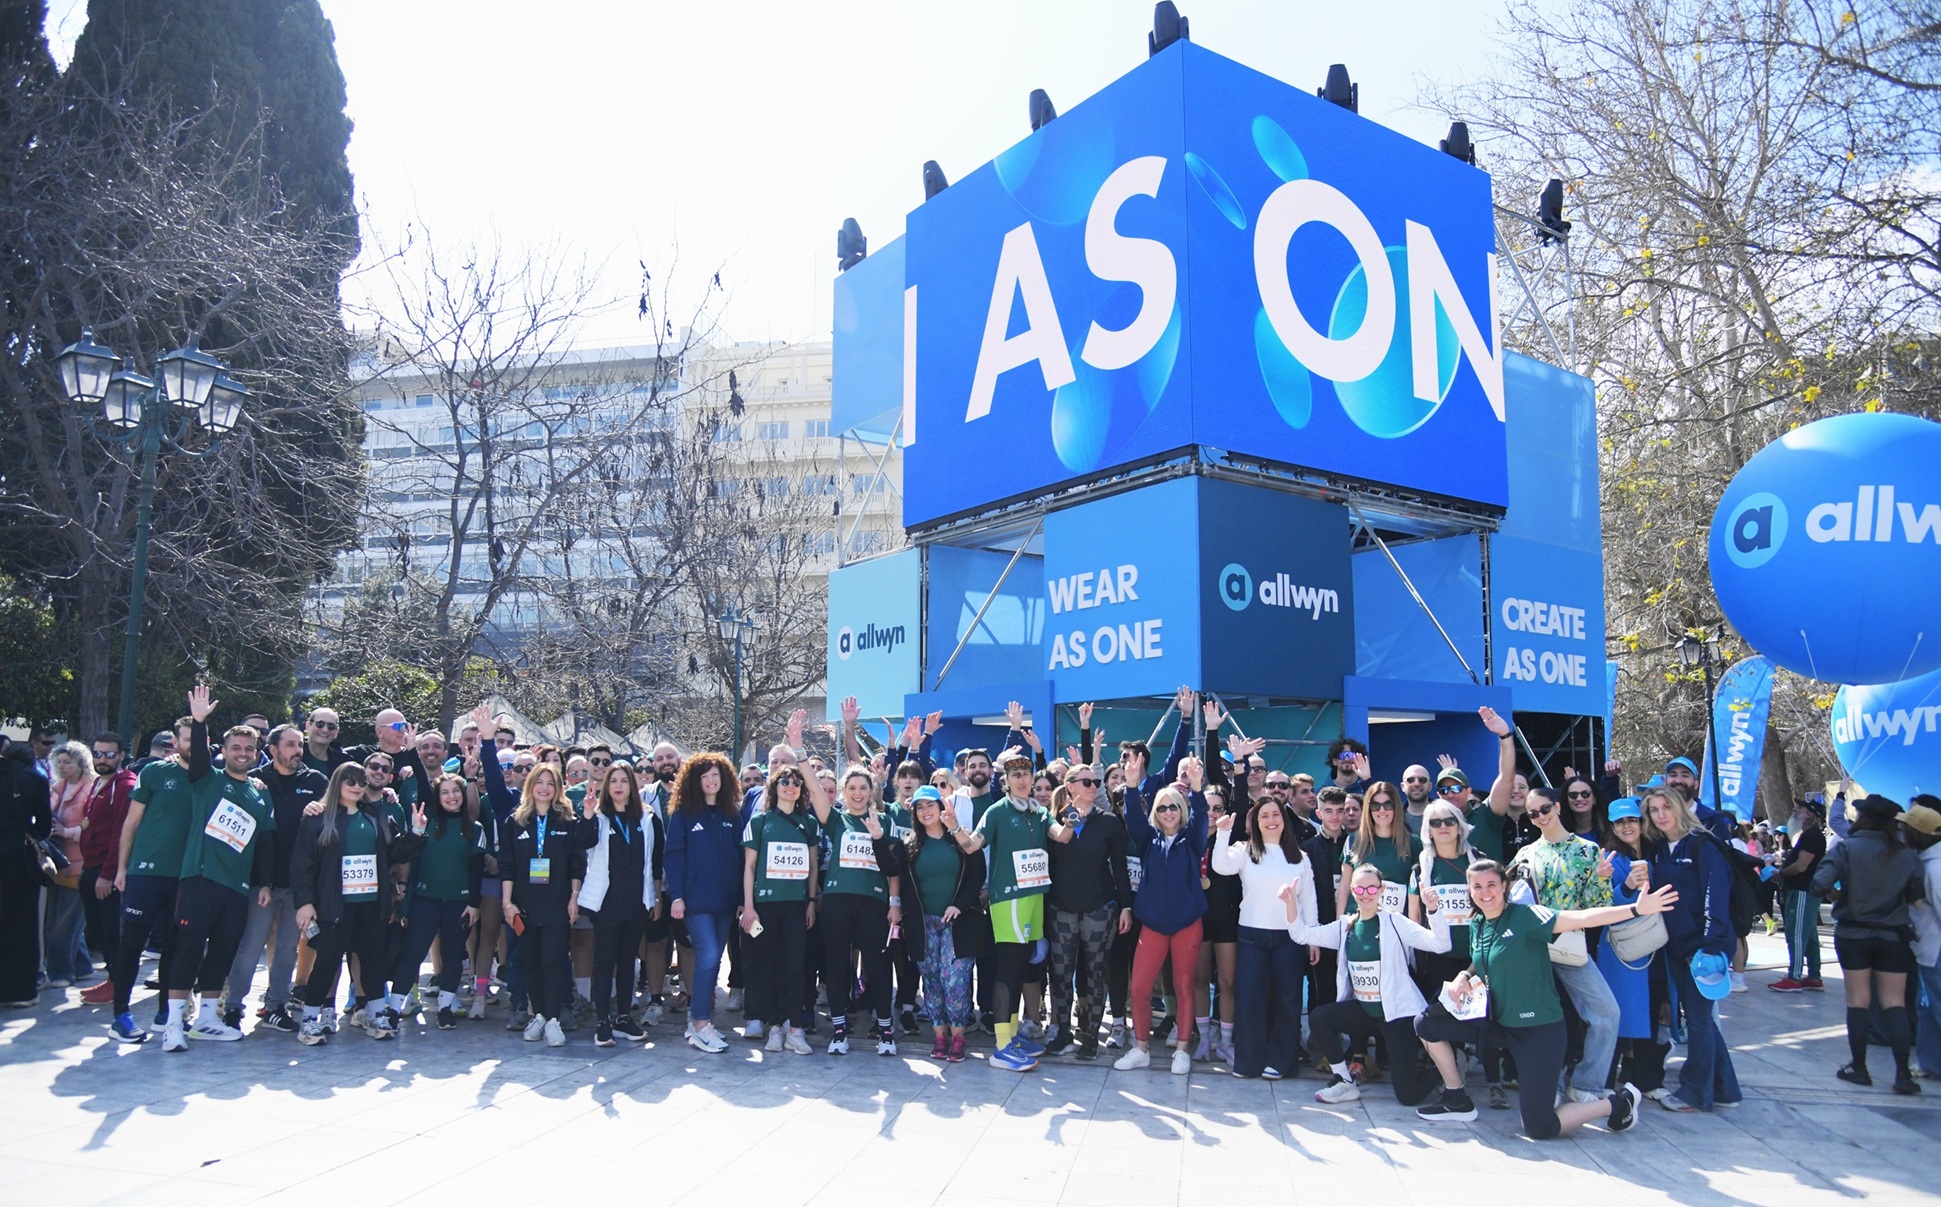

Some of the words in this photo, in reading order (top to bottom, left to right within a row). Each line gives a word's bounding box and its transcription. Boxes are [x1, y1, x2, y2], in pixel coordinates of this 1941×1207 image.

[965, 156, 1177, 423] AS
[1254, 179, 1506, 422] ON
[1048, 564, 1139, 614] WEAR
[1259, 572, 1339, 620] allwyn
[857, 623, 905, 654] allwyn
[1502, 597, 1586, 640] CREATE
[1049, 631, 1086, 670] AS
[1092, 619, 1163, 664] ONE
[1503, 647, 1537, 682] AS
[1540, 651, 1587, 687] ONE
[1718, 712, 1754, 796] allwyn
[218, 814, 246, 836] 61511
[773, 855, 803, 866] 54126
[784, 845, 803, 853] allwyn
[1021, 861, 1046, 873] 55680
[343, 868, 374, 880] 53379
